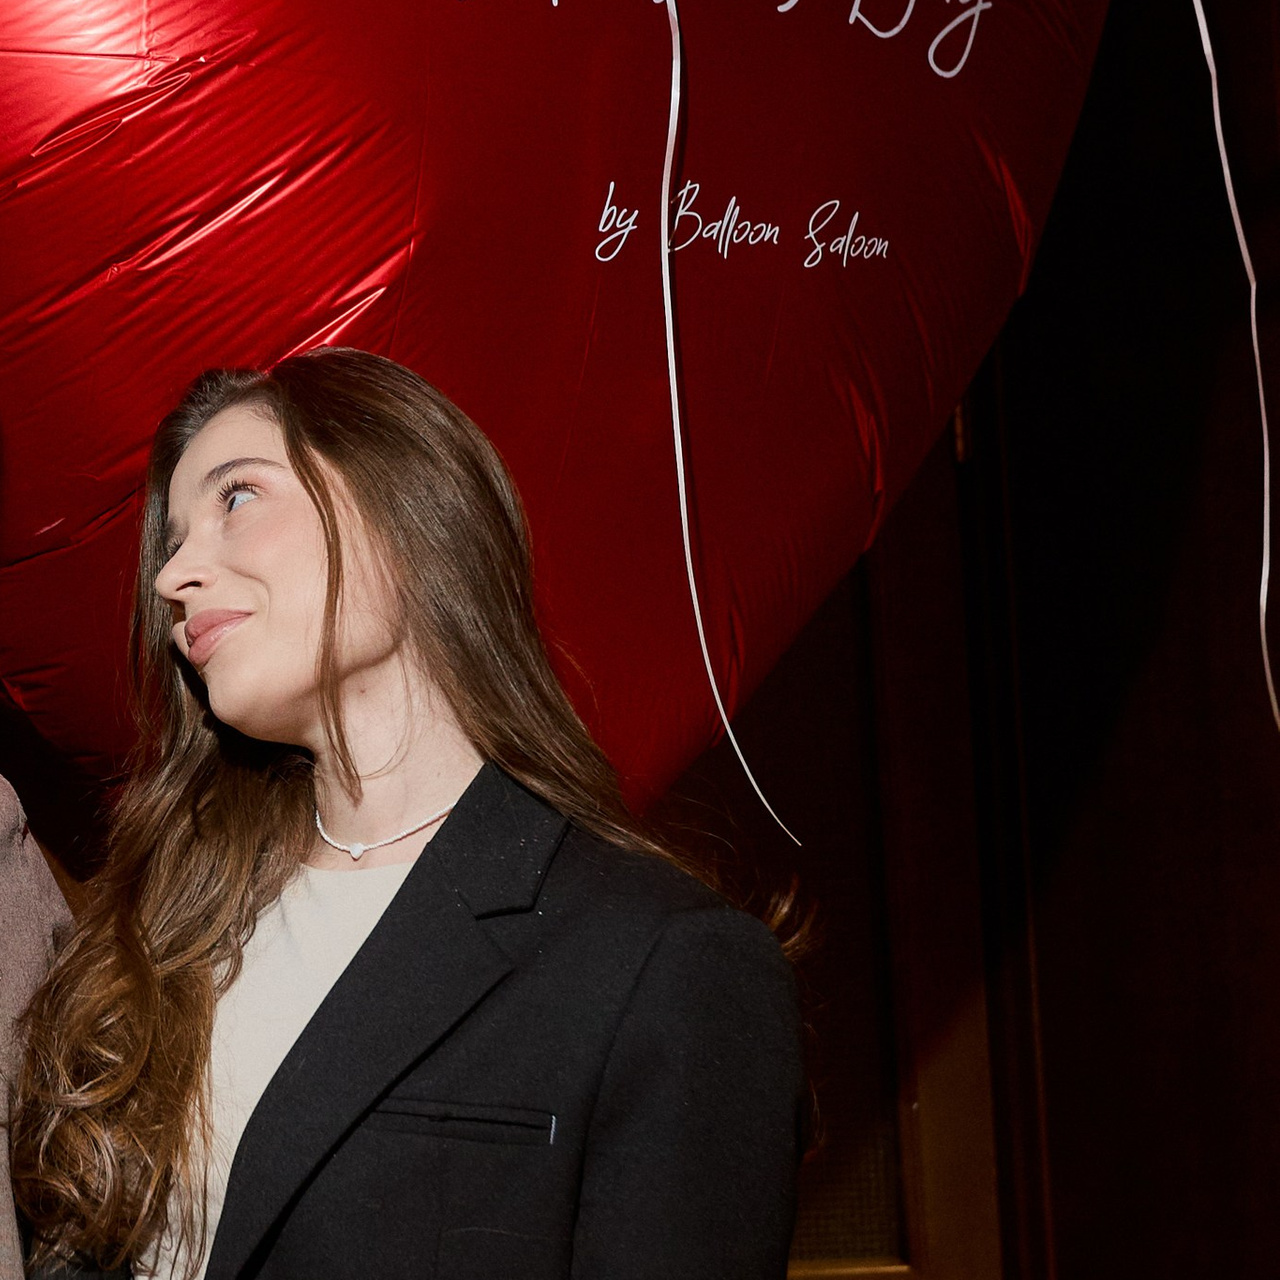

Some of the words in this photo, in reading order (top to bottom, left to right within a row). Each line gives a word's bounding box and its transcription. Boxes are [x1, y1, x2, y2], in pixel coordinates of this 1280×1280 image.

[594, 180, 639, 262] by
[669, 179, 781, 260] Balloon
[803, 199, 890, 269] Saloon
